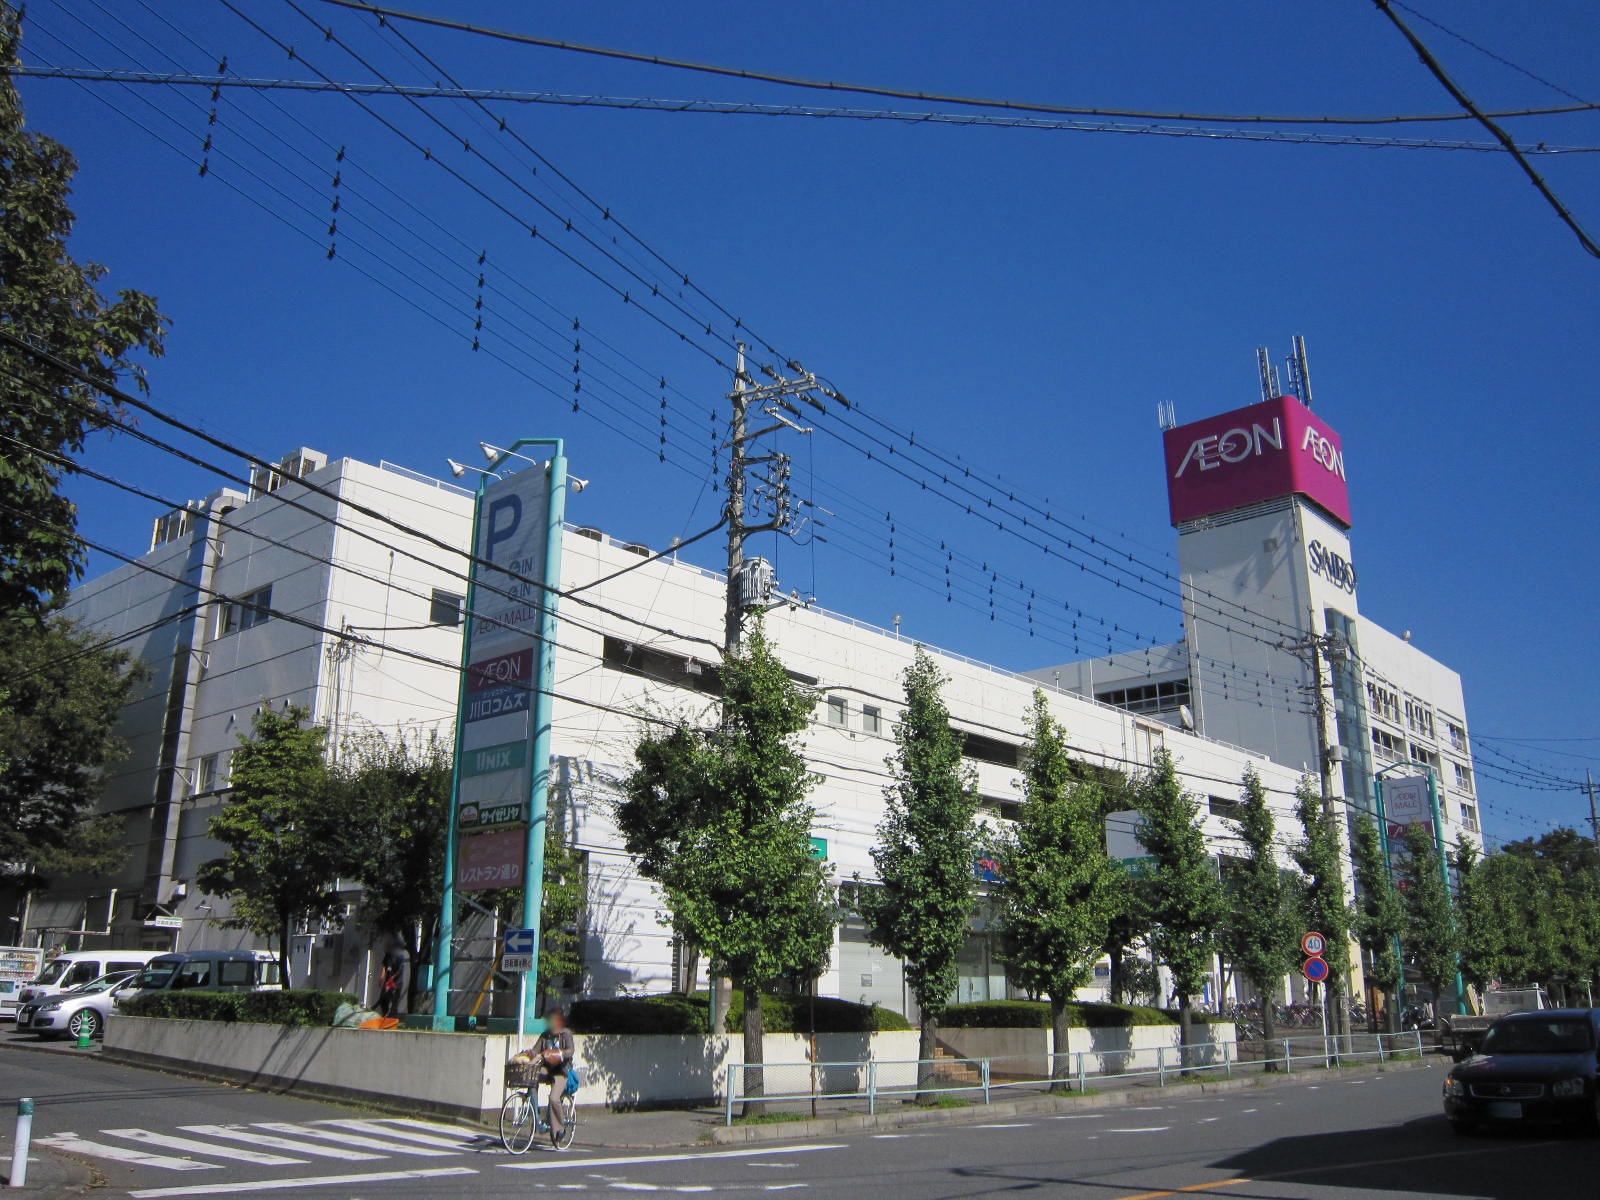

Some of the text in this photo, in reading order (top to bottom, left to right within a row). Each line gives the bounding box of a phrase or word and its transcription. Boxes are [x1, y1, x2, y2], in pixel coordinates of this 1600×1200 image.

[486, 494, 522, 573] P
[1308, 538, 1358, 595] SAIBO
[504, 607, 535, 626] MALL
[469, 692, 526, 721] 川口コムズ
[480, 806, 520, 825] サイゼリヤ
[461, 863, 520, 884] レストラン通り
[1307, 938, 1321, 950] 40
